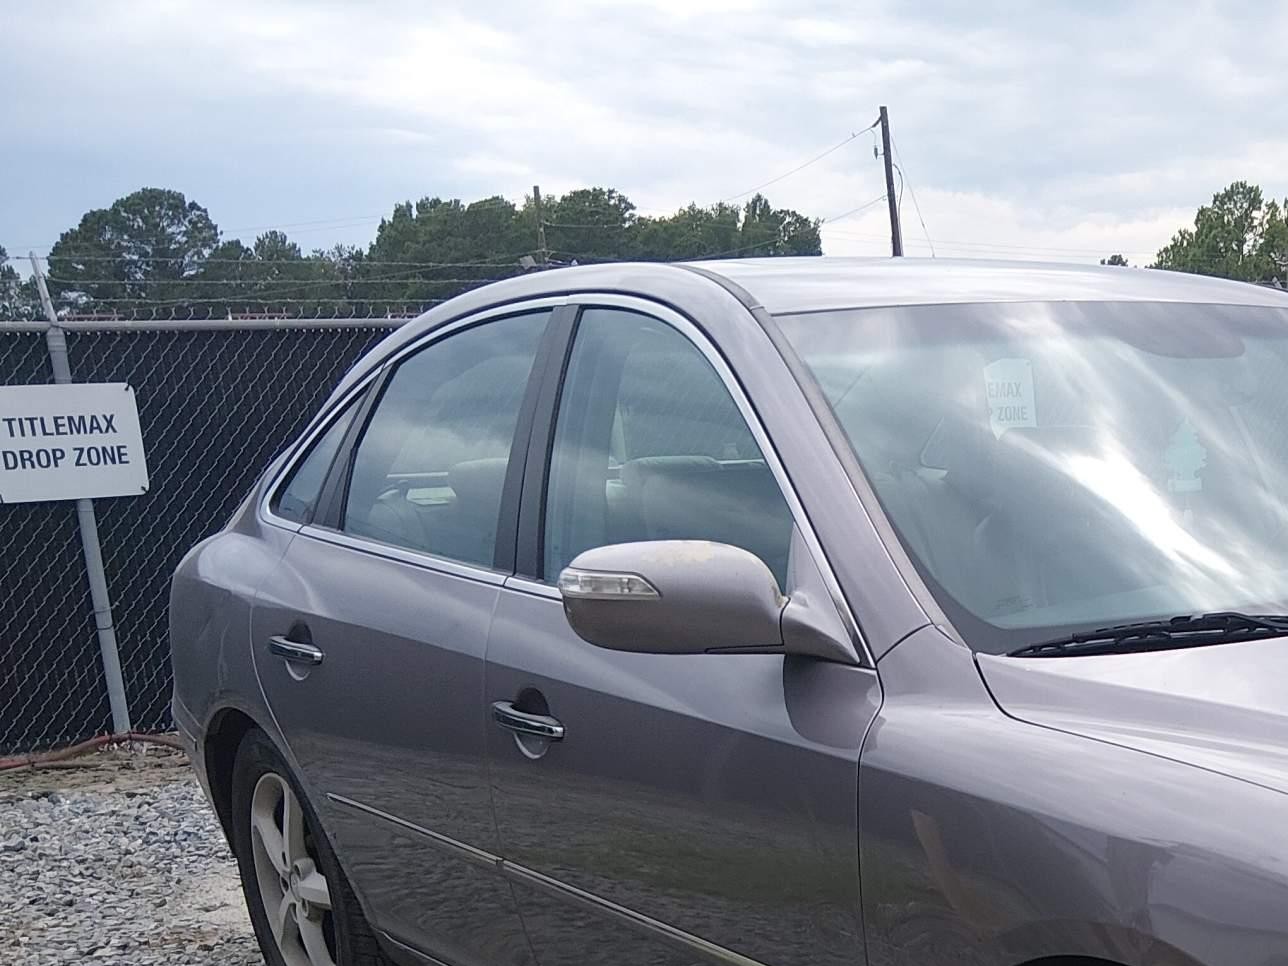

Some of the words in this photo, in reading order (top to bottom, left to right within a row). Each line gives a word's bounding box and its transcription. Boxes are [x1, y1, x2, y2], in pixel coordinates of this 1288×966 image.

[998, 406, 1029, 421] ZONE
[2, 414, 118, 438] TITLEMAX
[2, 447, 66, 471] DROP
[72, 445, 130, 467] ZONE
